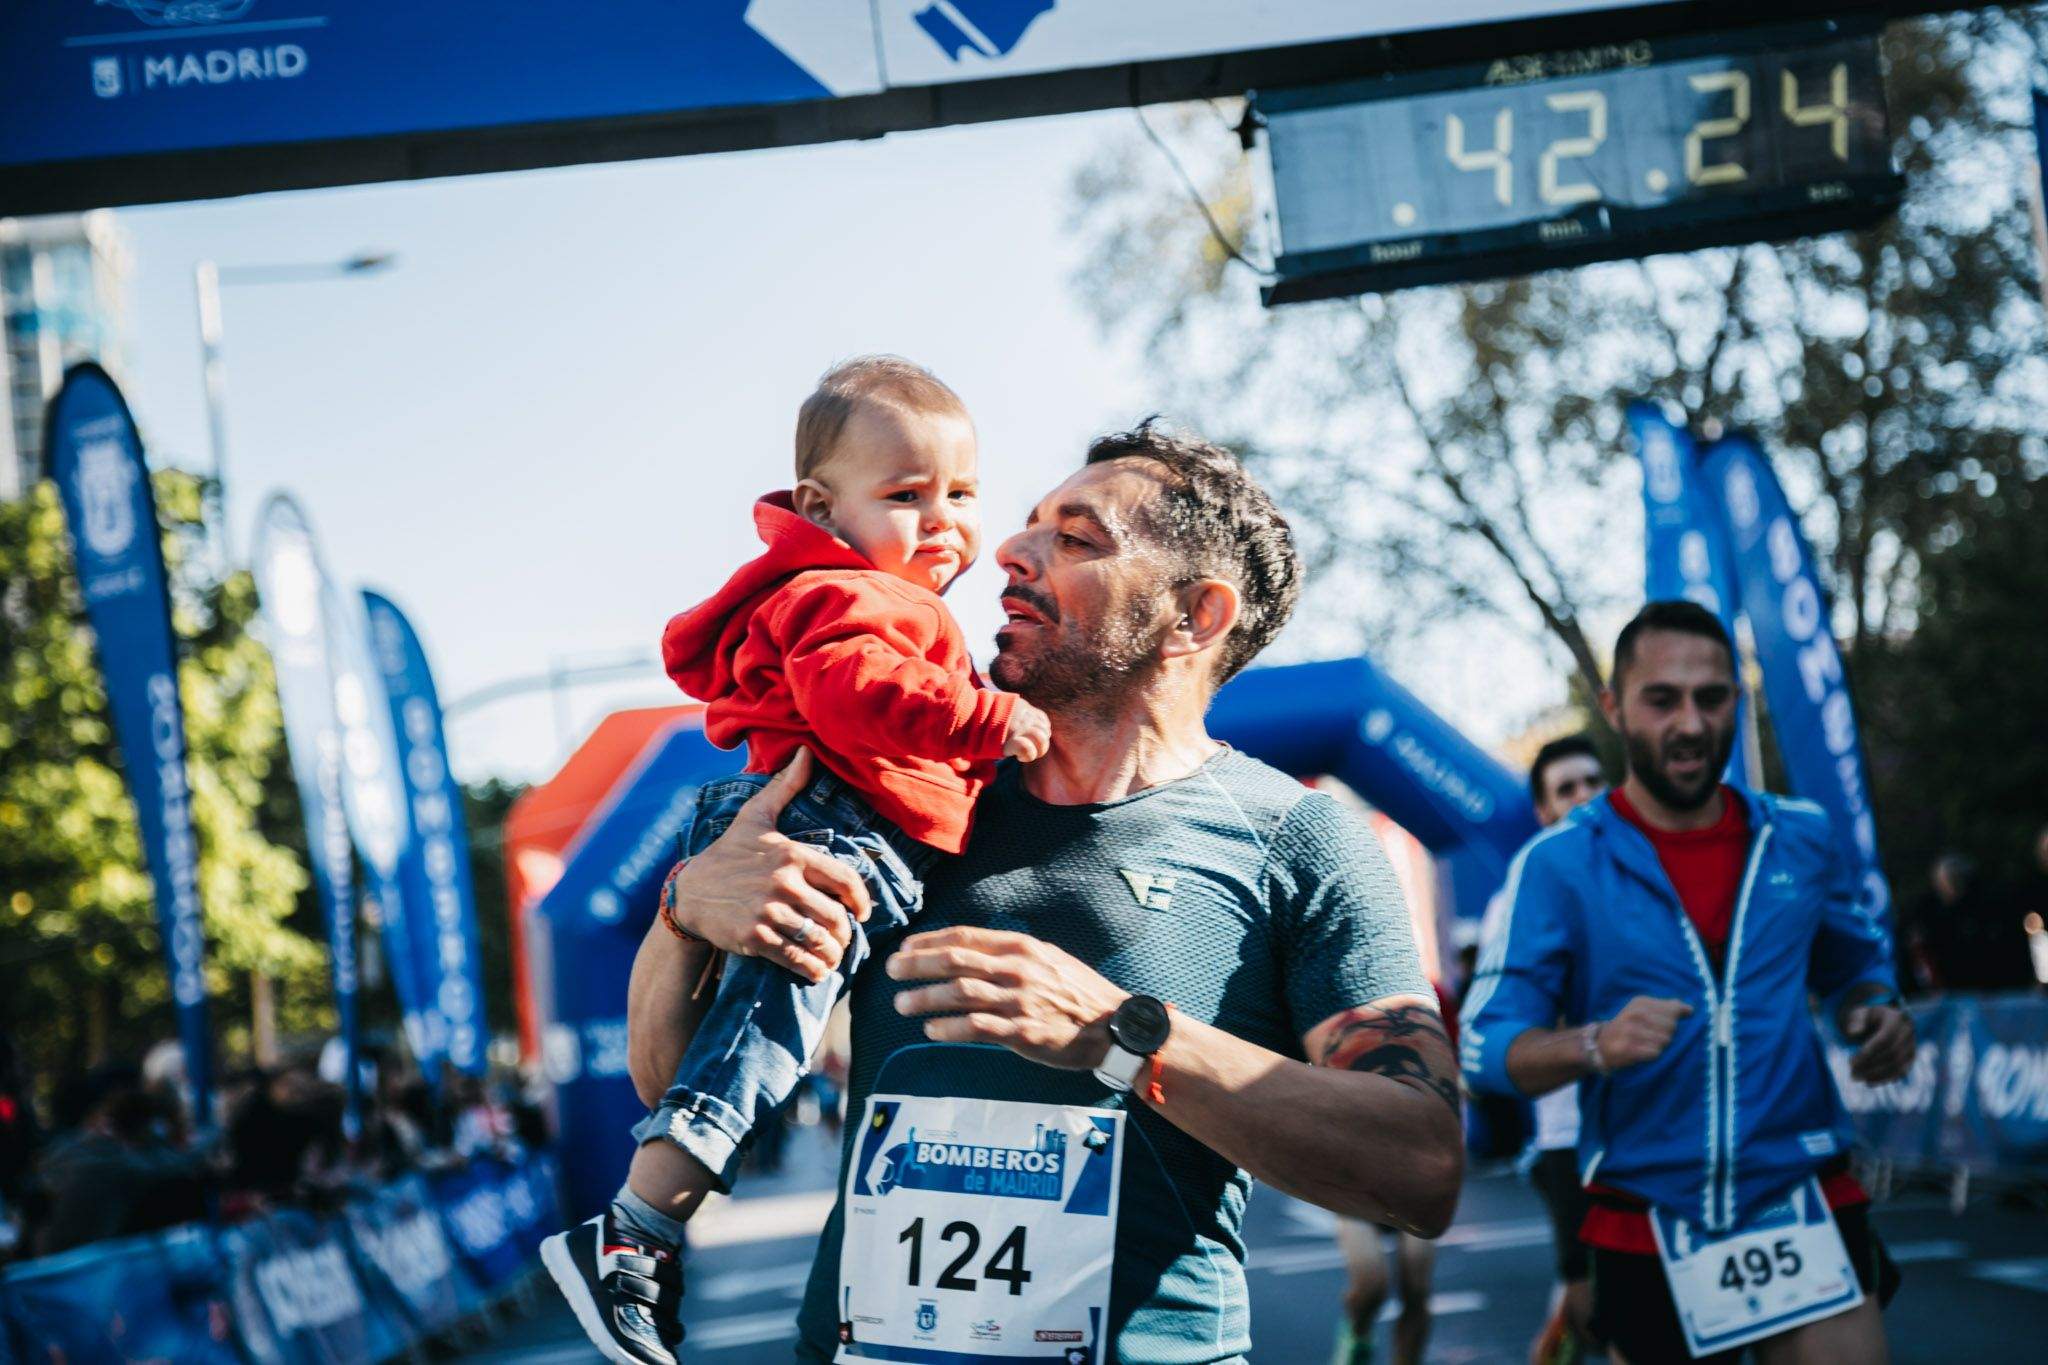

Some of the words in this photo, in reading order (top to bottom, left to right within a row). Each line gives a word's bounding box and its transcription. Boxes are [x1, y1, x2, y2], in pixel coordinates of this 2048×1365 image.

[144, 45, 307, 87] MADRID
[916, 1143, 1060, 1174] BOMBEROS
[963, 1169, 985, 1192] de
[989, 1171, 1058, 1197] MADRID
[899, 1217, 1032, 1296] 124
[1719, 1240, 1802, 1293] 495
